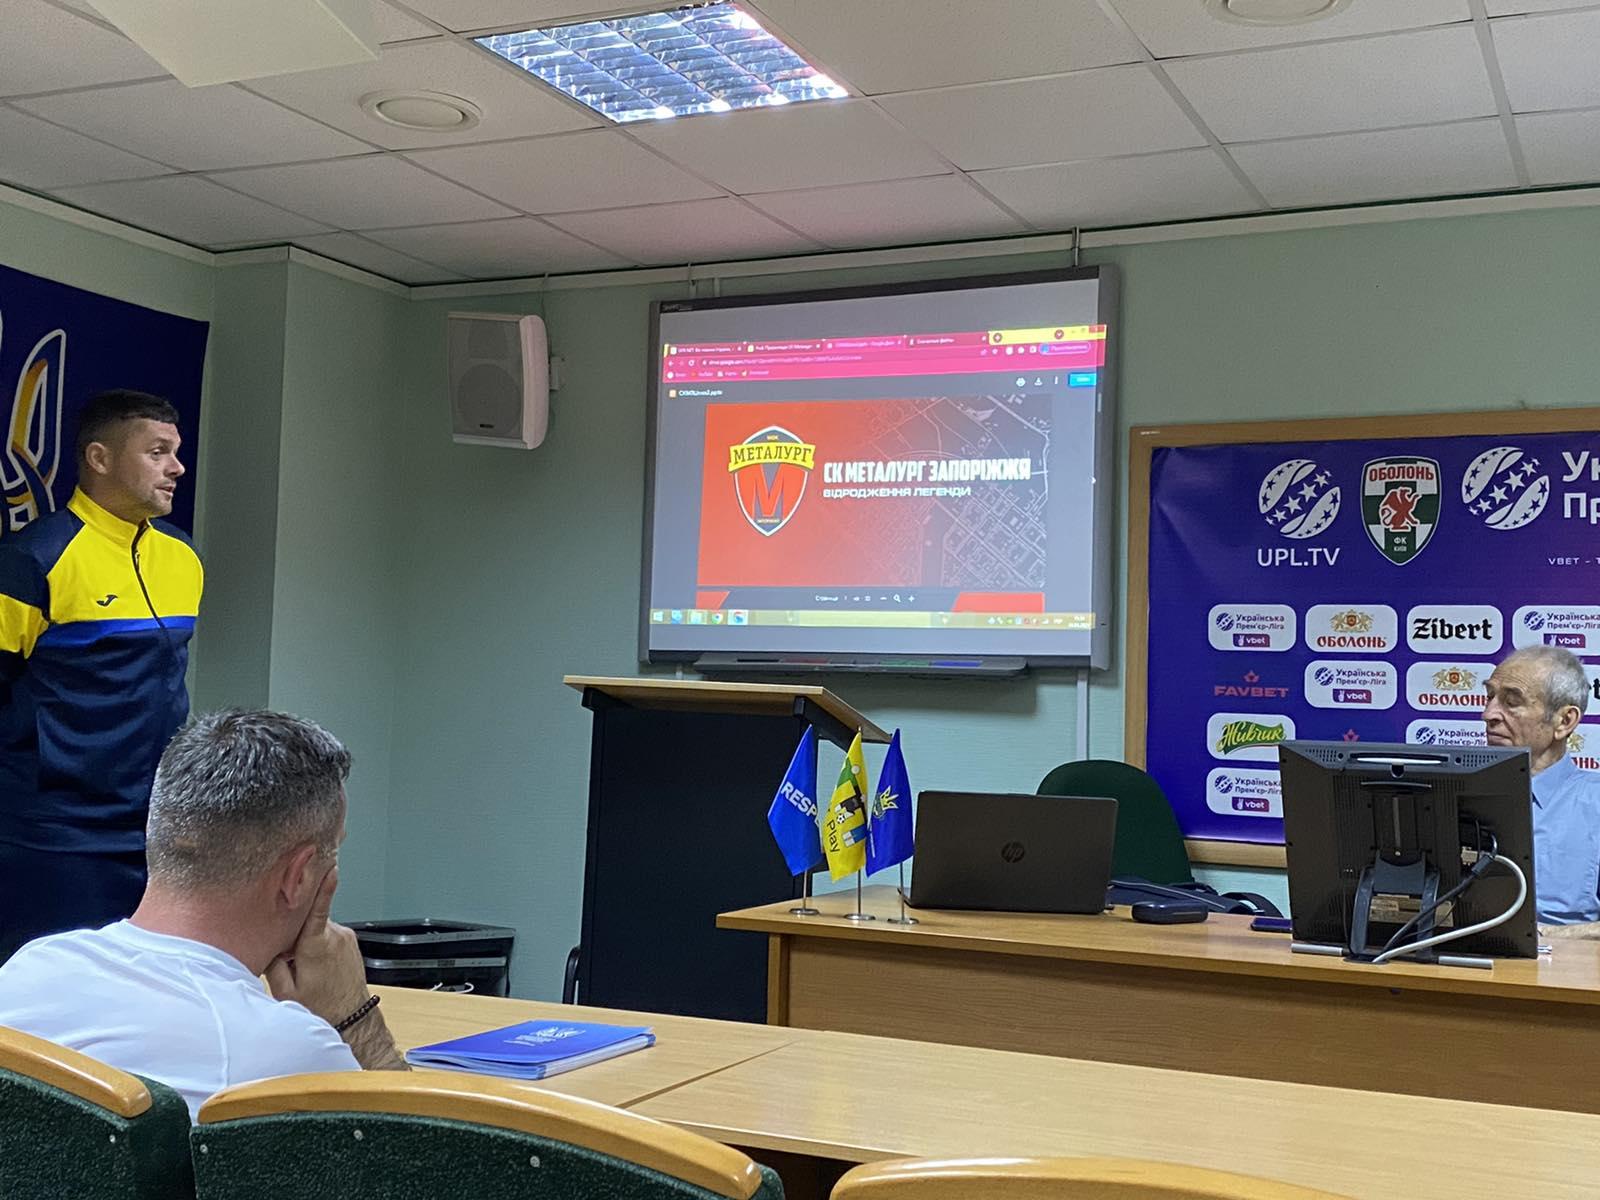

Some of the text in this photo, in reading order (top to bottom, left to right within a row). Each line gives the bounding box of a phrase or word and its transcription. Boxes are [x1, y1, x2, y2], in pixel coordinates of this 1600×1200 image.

[733, 445, 812, 465] МЕТАЛУРГ
[823, 458, 1031, 483] СК МЕТАЛУРГ ЗАПОРІЖЖЯ
[1369, 466, 1435, 482] ОБОЛОНЬ
[823, 486, 971, 499] ВІДРОДЖЕННЯ ЛЕГЕНДИ
[1393, 536, 1407, 545] ФК
[1257, 547, 1340, 567] UPL.TV
[1548, 557, 1580, 565] VBET
[1236, 613, 1285, 623] Українська
[1413, 618, 1493, 640] Zibert
[1246, 636, 1266, 644] vbet
[1317, 636, 1387, 648] ОБОЛОНЬ
[1558, 637, 1581, 645] vbet
[1335, 668, 1387, 679] Українська
[1214, 685, 1289, 698] FAVBET
[1347, 691, 1367, 700] vbet
[1438, 728, 1486, 739] Українськ
[1235, 777, 1281, 788] Українськ
[1235, 786, 1281, 796] Прем'єр-Ліг
[1245, 802, 1265, 810] vbet
[826, 820, 841, 854] Play
